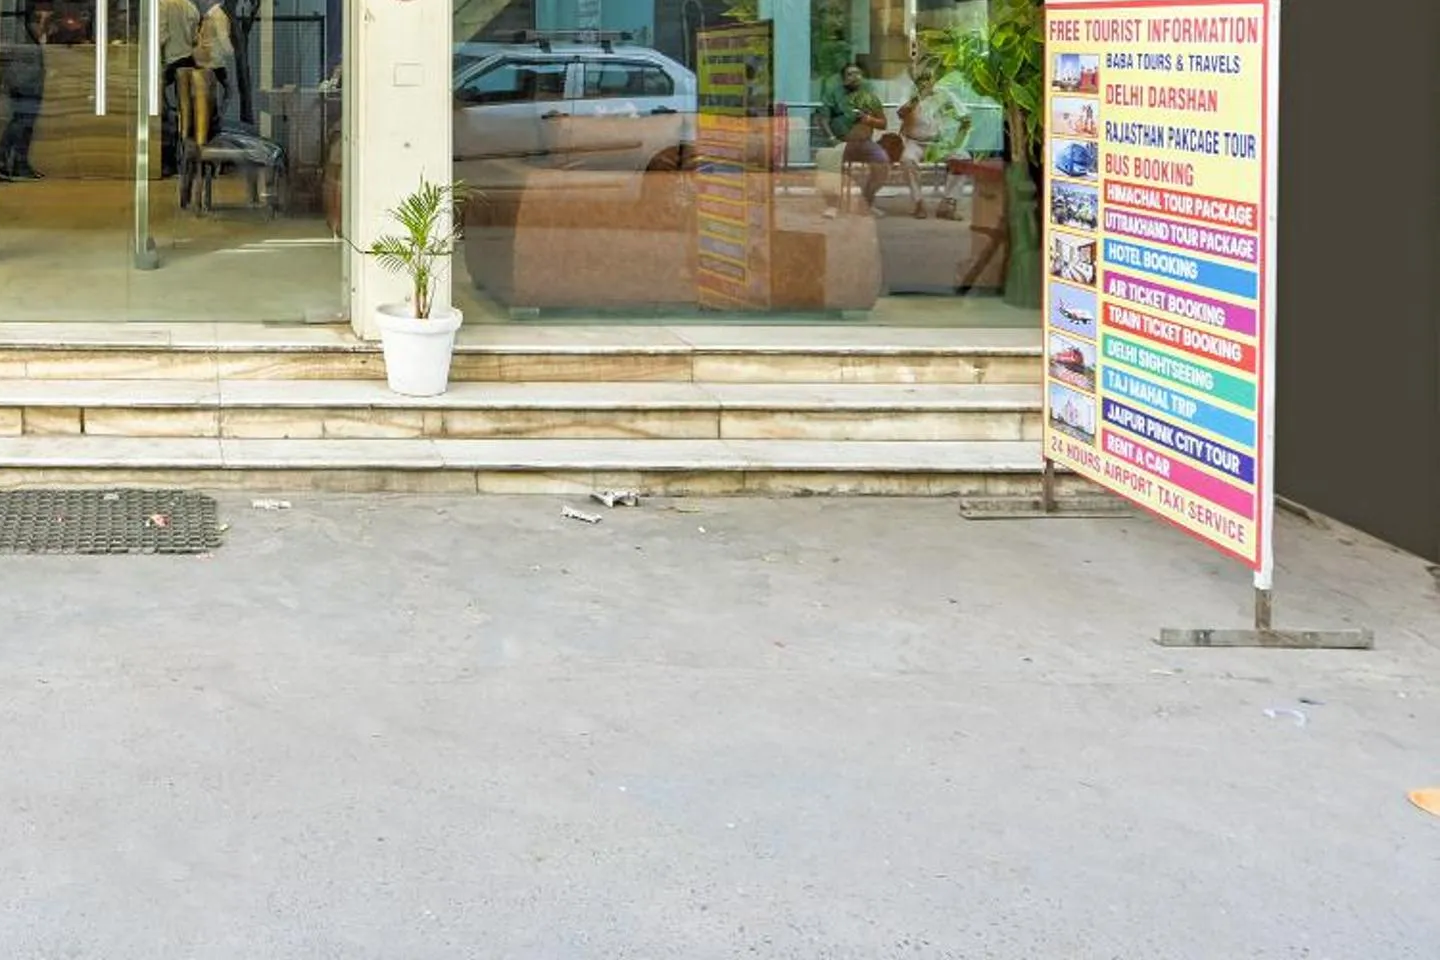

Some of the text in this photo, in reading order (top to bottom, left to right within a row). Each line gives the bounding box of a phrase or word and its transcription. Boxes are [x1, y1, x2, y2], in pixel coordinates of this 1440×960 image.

[1049, 16, 1258, 43] FREE TOURIST INFORMATION
[1105, 53, 1240, 74] BABA TOURS & TRAVELS
[1105, 84, 1218, 112] DELHI DARSHAN
[1105, 121, 1257, 159] RAJASTHAN PAKCAGE TOUR
[1105, 153, 1194, 186] BUS BOOKING
[1106, 183, 1253, 226] HIMACHAL TOUR PACKAGE
[1105, 211, 1255, 260] UTTRAKHAND TOUR PACKAGE
[1109, 243, 1198, 280] HOTEL BOOKING
[1109, 277, 1226, 326] AIR TICKET BOOKING
[1109, 307, 1242, 361] TRAIN TICKET BOOKING
[1107, 338, 1214, 390] DELHI SIGHTSEEING
[1108, 371, 1197, 420] TAJ MAHAL TRIP
[1107, 402, 1241, 474] JAIPUR PINK CITY TOUR
[1107, 434, 1171, 477] RENT A CAR
[1050, 436, 1245, 544] 24 HOURS AIRPORT TAXI SERVICE
